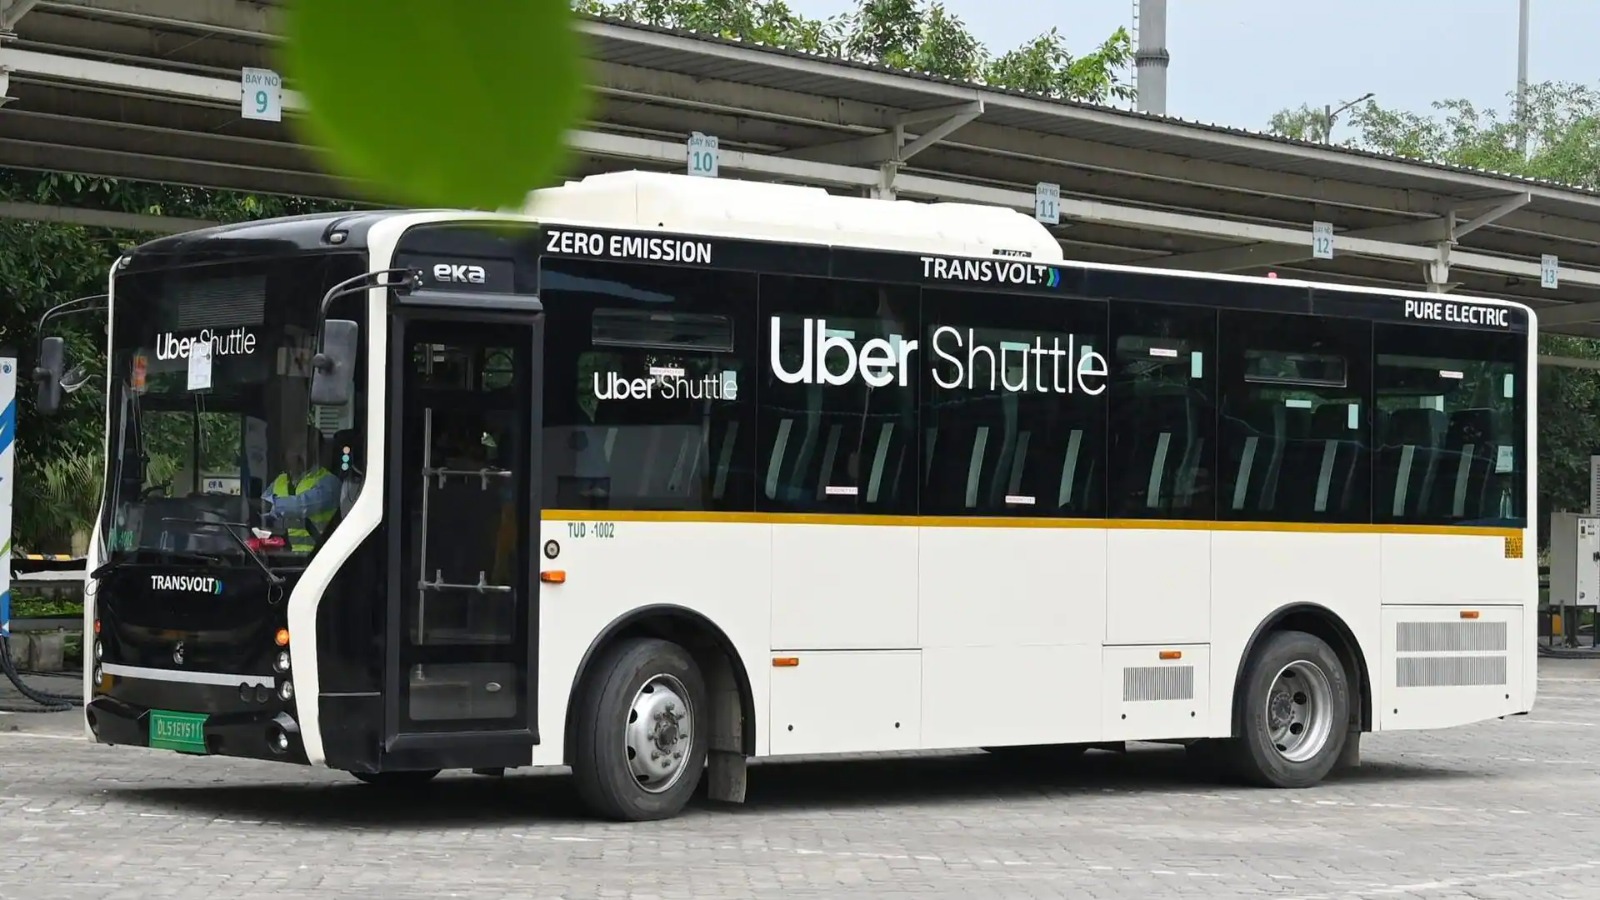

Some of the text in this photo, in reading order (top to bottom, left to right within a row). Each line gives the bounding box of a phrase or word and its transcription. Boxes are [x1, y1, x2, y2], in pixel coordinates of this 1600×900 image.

[245, 74, 278, 86] BAY NO
[256, 91, 267, 113] 9
[693, 151, 712, 172] 10
[1040, 200, 1055, 219] 11
[546, 231, 712, 264] ZERO EMISSION
[1317, 238, 1330, 254] 12
[920, 257, 1047, 284] TRANSVOLT
[1545, 269, 1555, 284] 13
[1405, 300, 1508, 327] PURE ELECTRIC
[156, 327, 256, 360] Uber Shuttle
[771, 316, 1108, 395] Uber Shuttle
[594, 371, 738, 399] Uber Shuttle
[568, 522, 586, 538] TUD
[151, 575, 215, 593] TRANSVOLT
